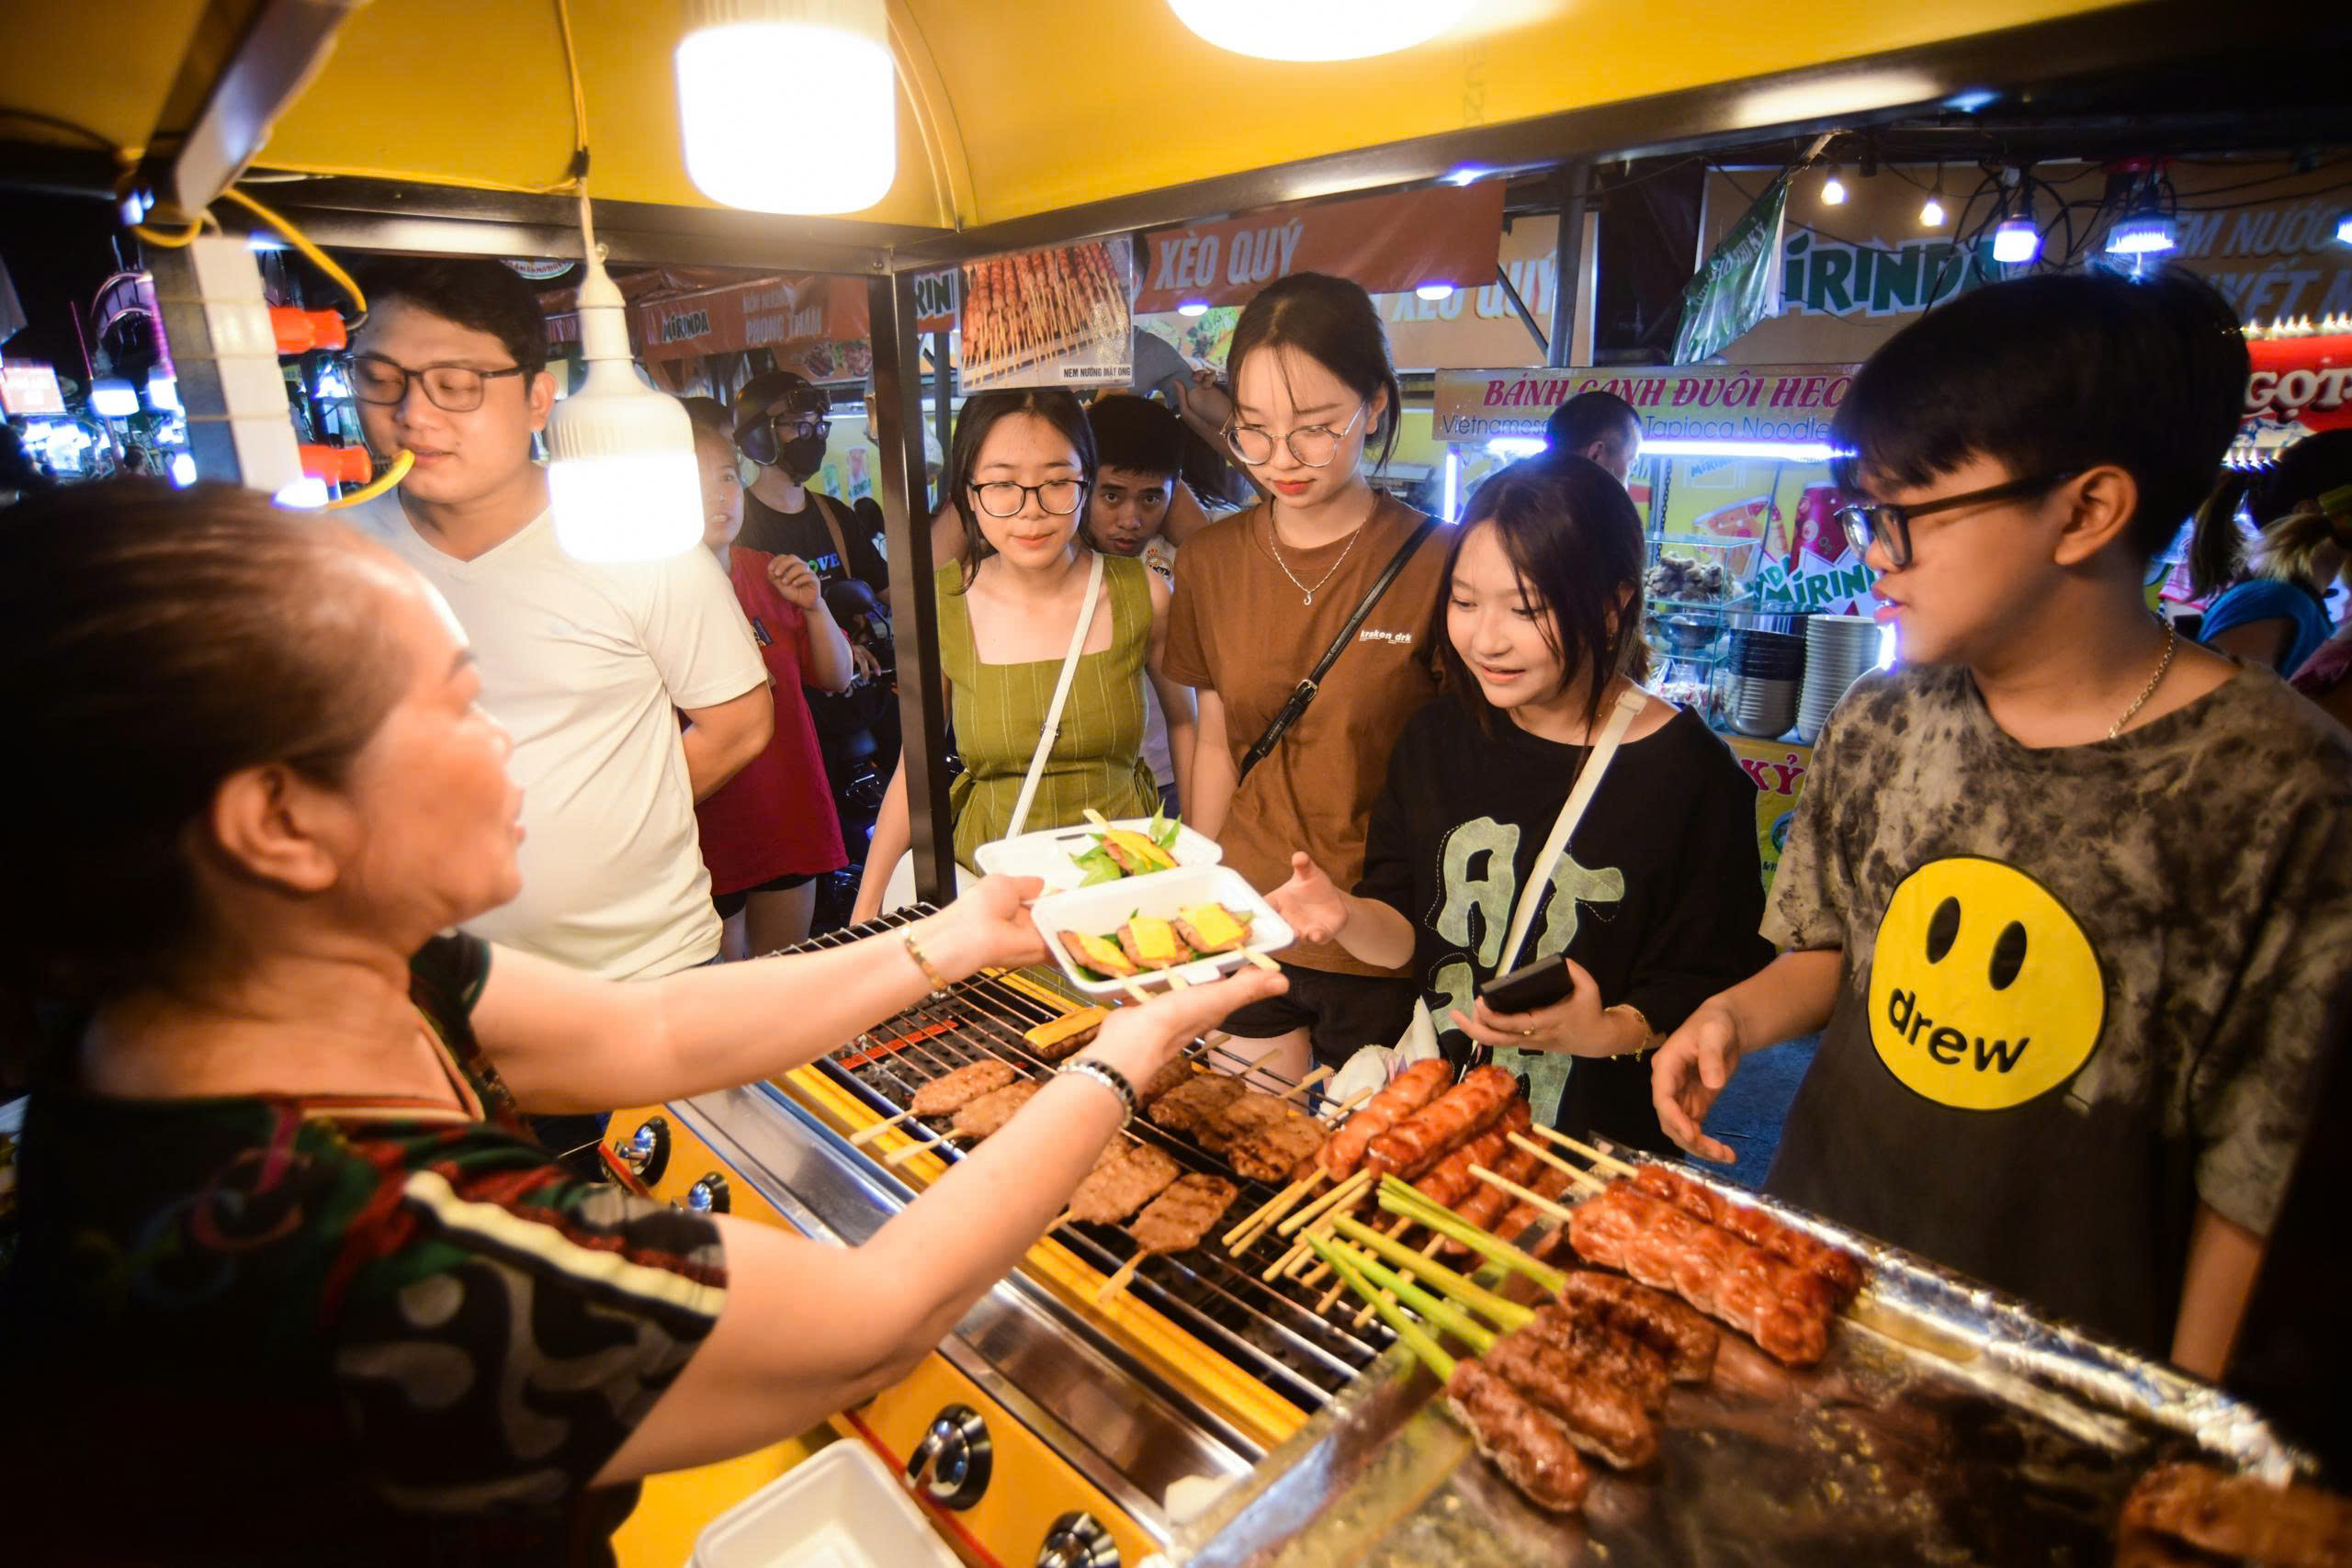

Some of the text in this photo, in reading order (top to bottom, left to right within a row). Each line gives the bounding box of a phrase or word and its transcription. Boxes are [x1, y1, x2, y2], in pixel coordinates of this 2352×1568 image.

[1154, 217, 1305, 289] XÈO QUÝ
[1483, 373, 1569, 406] BÁNH
[1672, 369, 1765, 408] ĐUÔI
[1645, 415, 1735, 440] Tapioca
[1888, 987, 2030, 1074] drew
